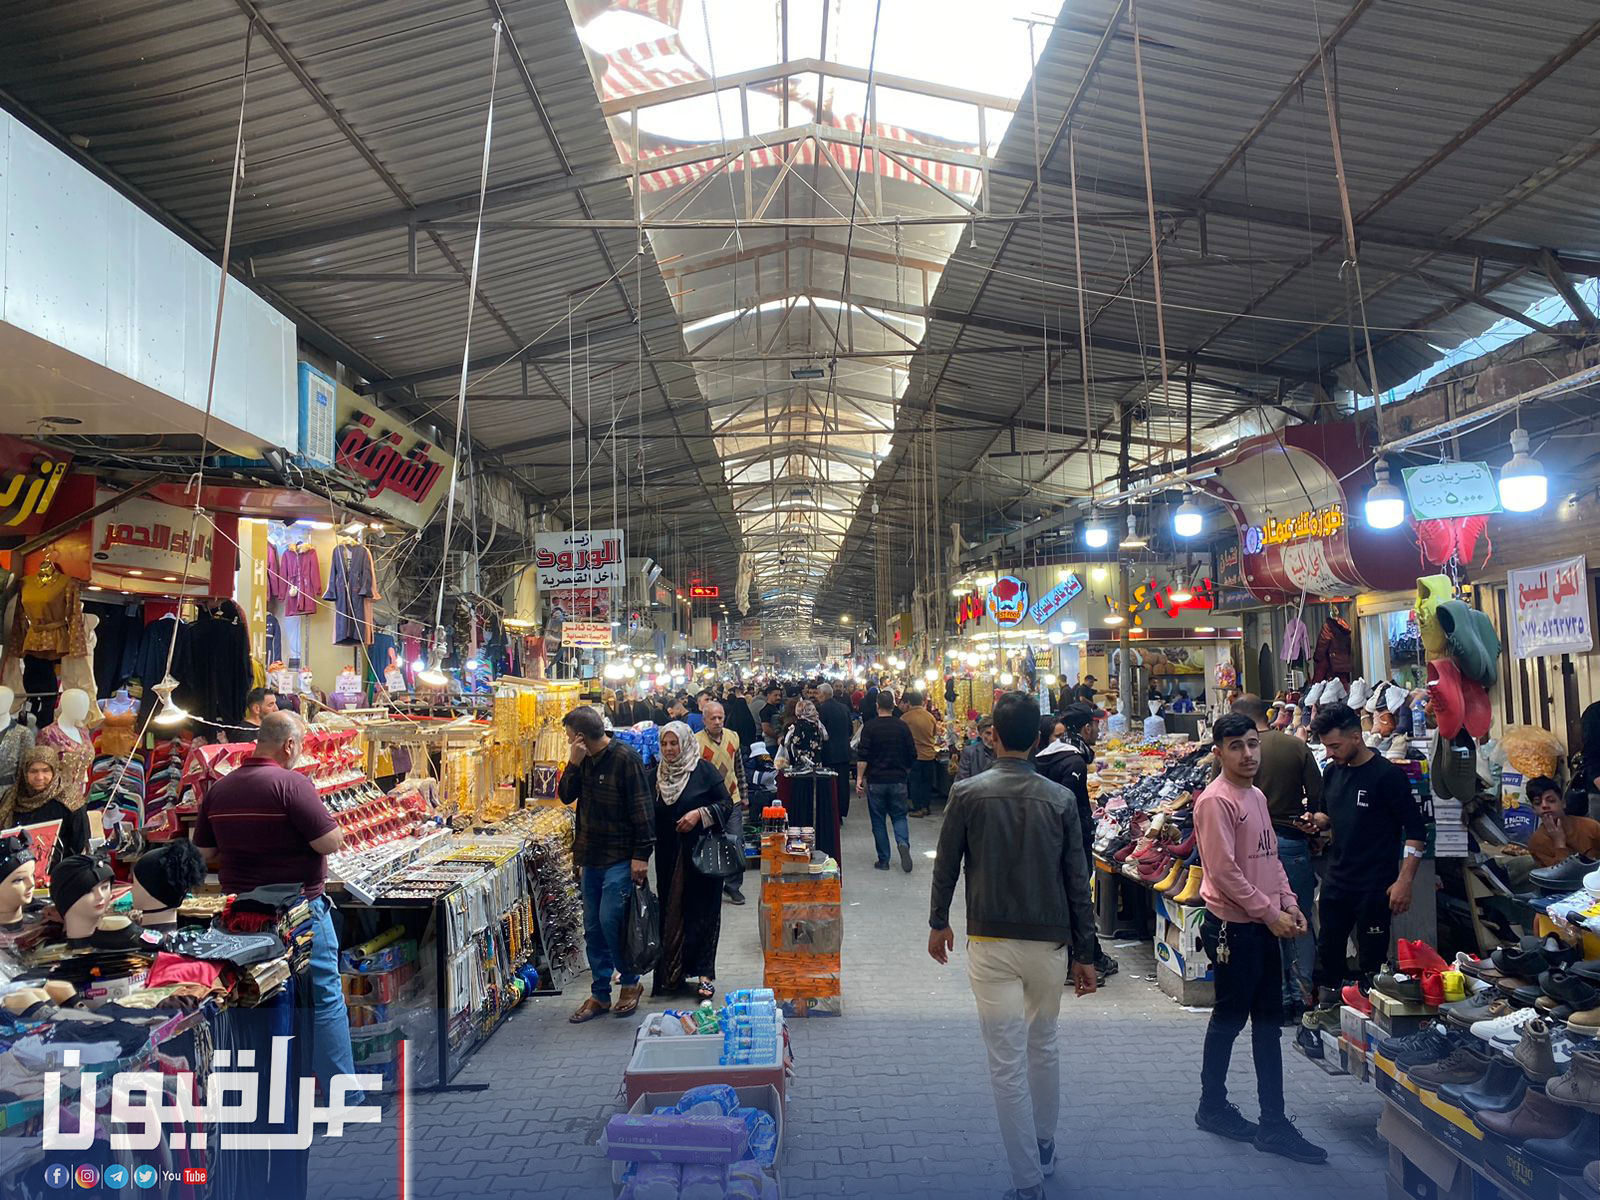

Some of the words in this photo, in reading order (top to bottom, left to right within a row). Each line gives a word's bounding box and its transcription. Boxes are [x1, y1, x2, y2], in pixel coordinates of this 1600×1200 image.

[1420, 469, 1482, 484] تنزيلات
[536, 539, 622, 572] الورود
[541, 572, 591, 588] القيصرية
[1518, 571, 1549, 610] للبيع
[1552, 565, 1579, 605] المحل
